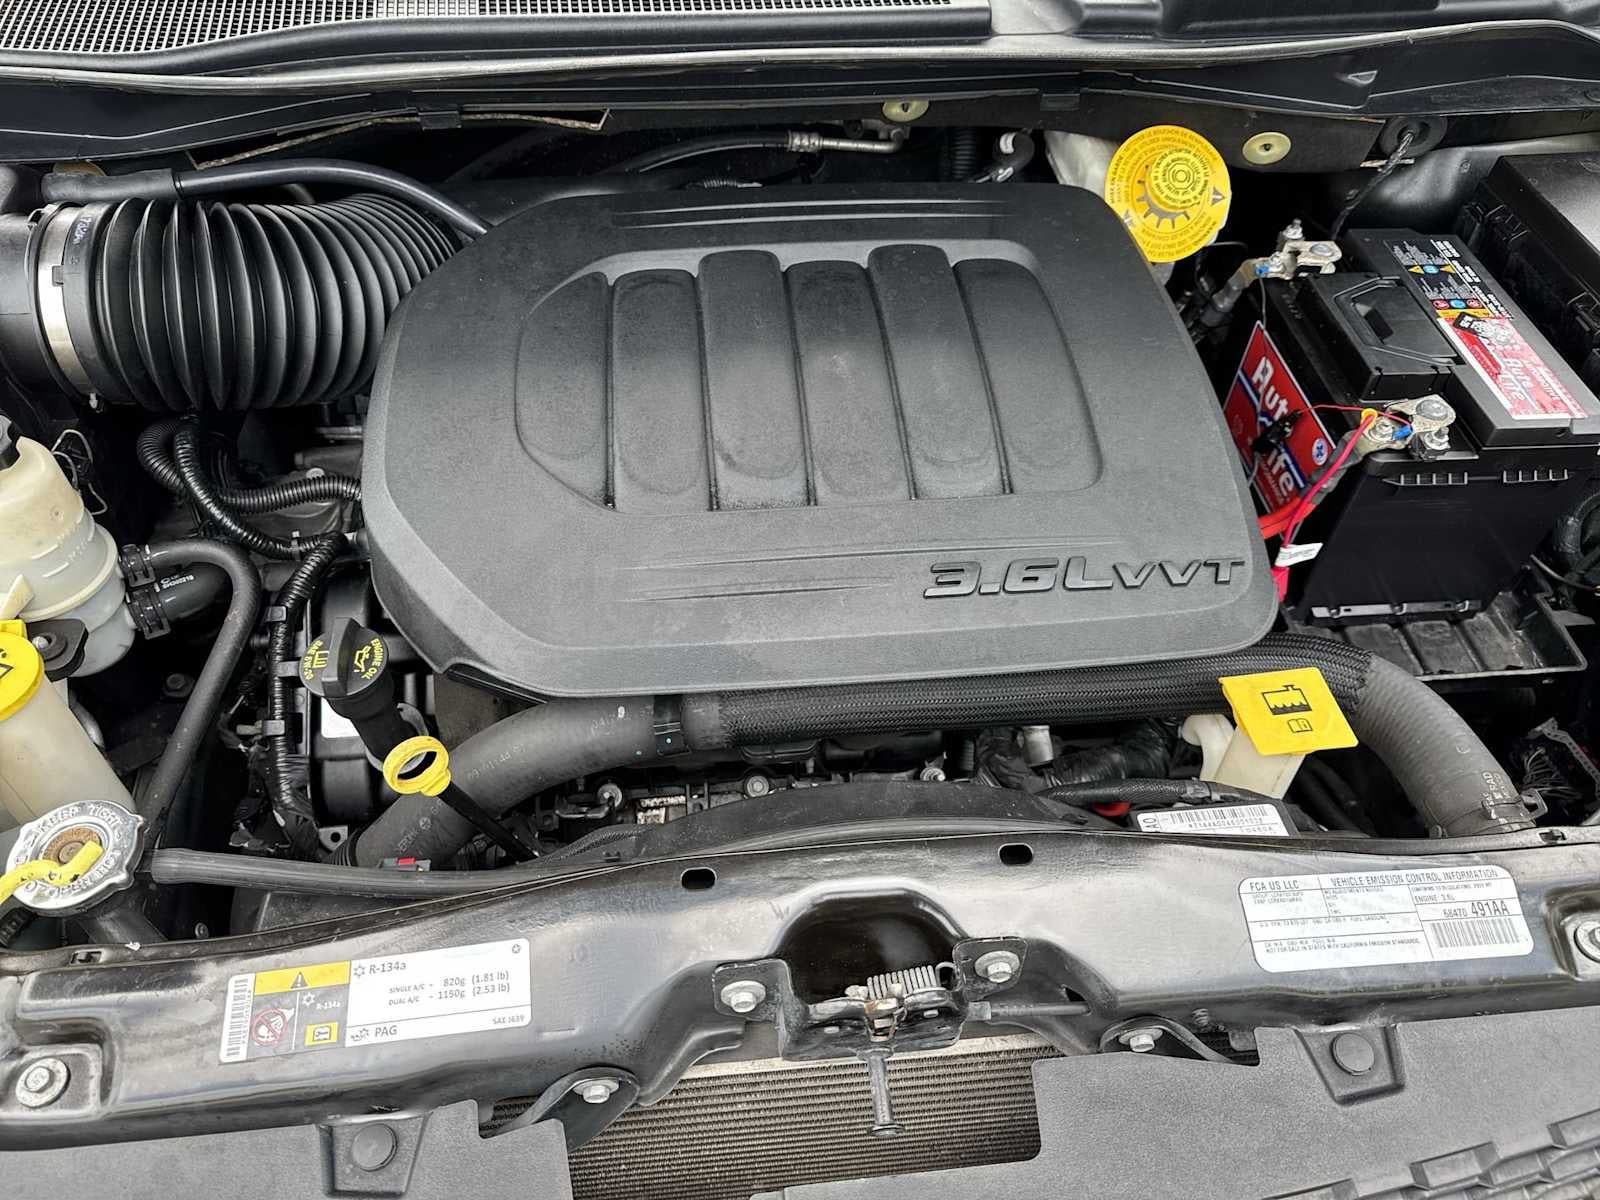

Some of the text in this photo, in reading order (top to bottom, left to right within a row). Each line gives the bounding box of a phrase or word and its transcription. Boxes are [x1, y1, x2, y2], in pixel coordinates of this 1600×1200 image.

[361, 638, 383, 681] ENGINE OIL
[1249, 879, 1300, 891] FCA US LLC
[1330, 868, 1499, 888] VEHICLE EMISSION CONTROL INFORMATION
[1471, 900, 1510, 917] 491AA
[368, 961, 407, 975] R-134a
[388, 985, 412, 994] SINGLE
[413, 983, 425, 991] A/C
[443, 976, 466, 988] 820g
[471, 972, 494, 986] (1.81
[496, 970, 510, 981] lb)
[388, 998, 406, 1006] DUAL
[407, 995, 420, 1004] A/C
[438, 989, 466, 1000] 1150g
[471, 984, 496, 998] (2.53
[498, 982, 511, 993] lb)
[374, 1025, 397, 1037] PAG
